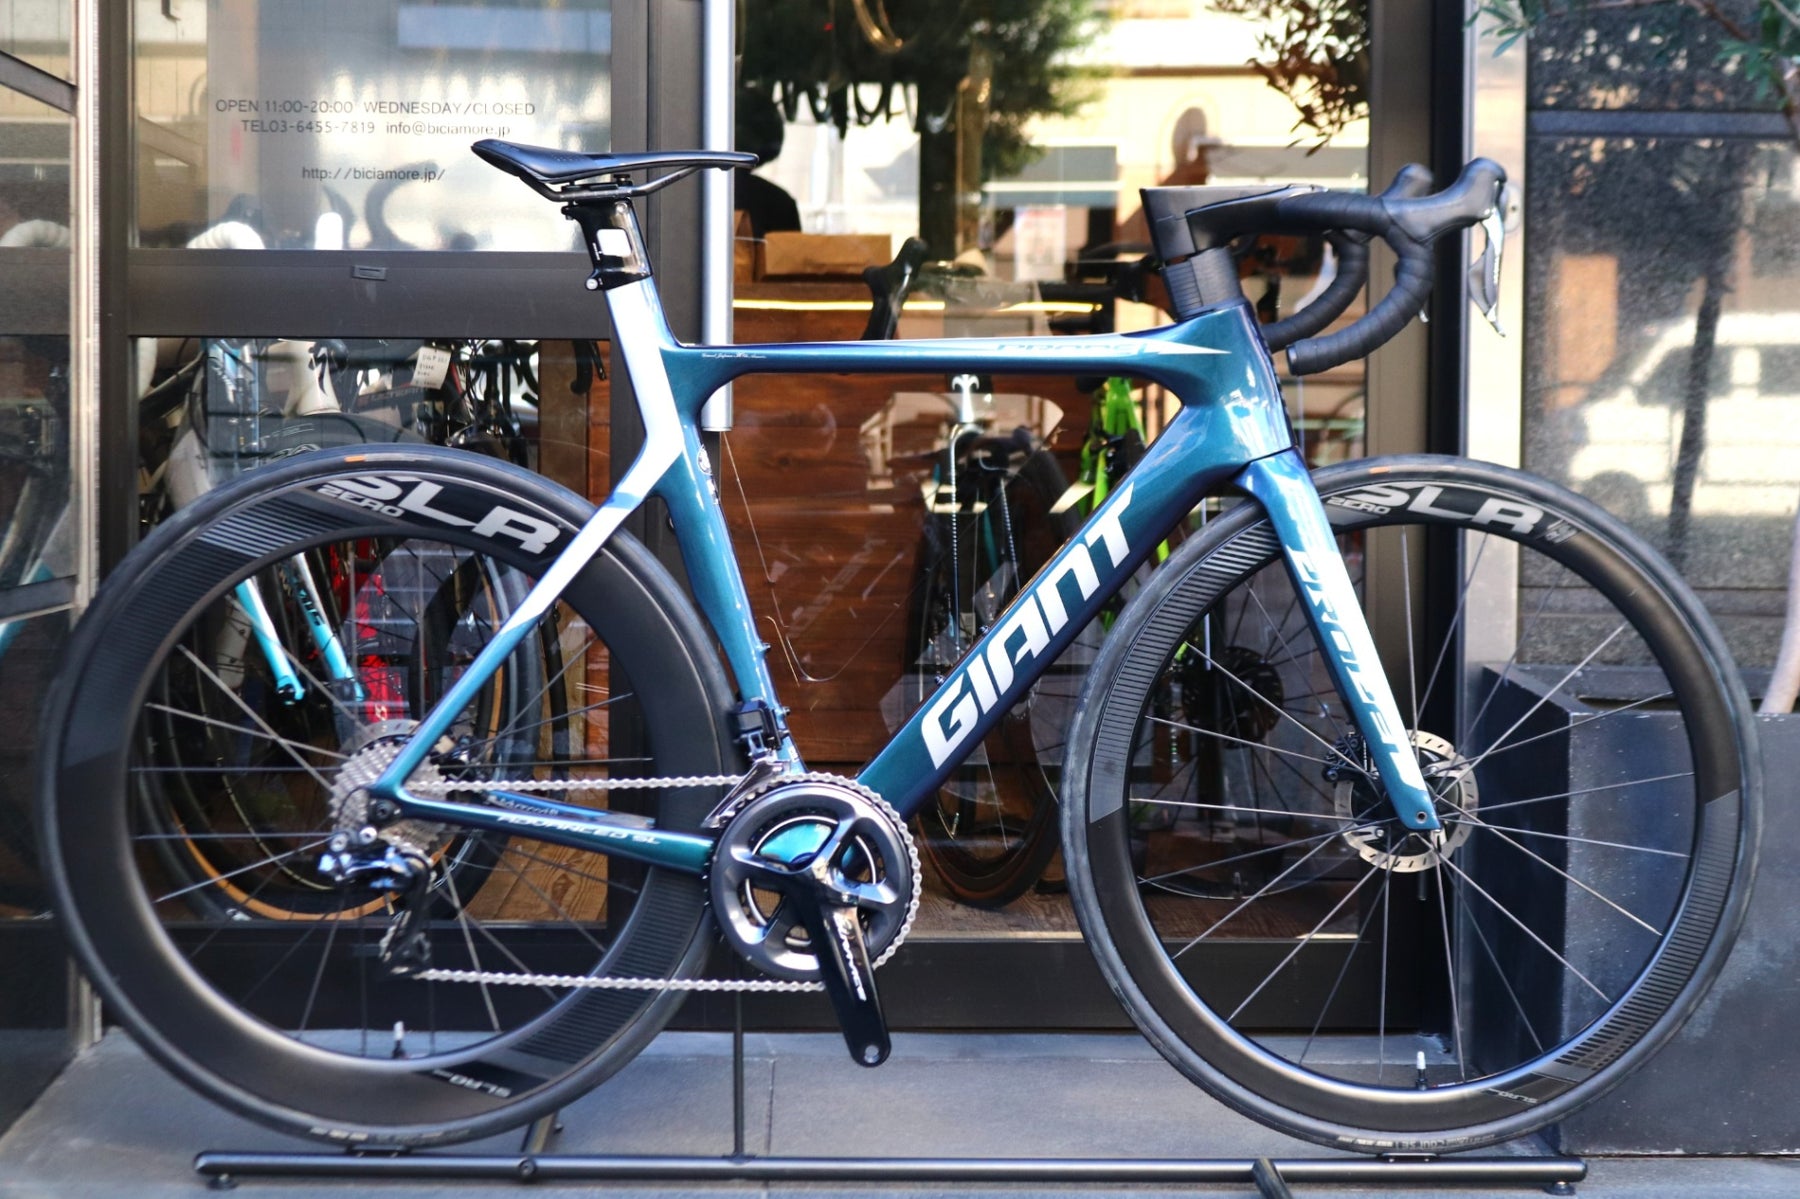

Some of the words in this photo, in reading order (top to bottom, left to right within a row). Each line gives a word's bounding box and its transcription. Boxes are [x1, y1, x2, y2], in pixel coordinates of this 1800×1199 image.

[215, 99, 260, 113] OPEN
[265, 100, 354, 114] 11:00-20:00
[364, 101, 536, 116] WEDNESDAY/CLOSED
[241, 119, 376, 133] TEL03-6455-7819
[386, 120, 511, 138] info@biciamore.jp
[302, 167, 446, 183] http://biciamore.jp/
[315, 484, 405, 518] ZERO
[1326, 496, 1391, 515] ZERO
[1350, 481, 1544, 535] SLR
[324, 476, 561, 554] SLR
[921, 481, 1135, 770] GIANT
